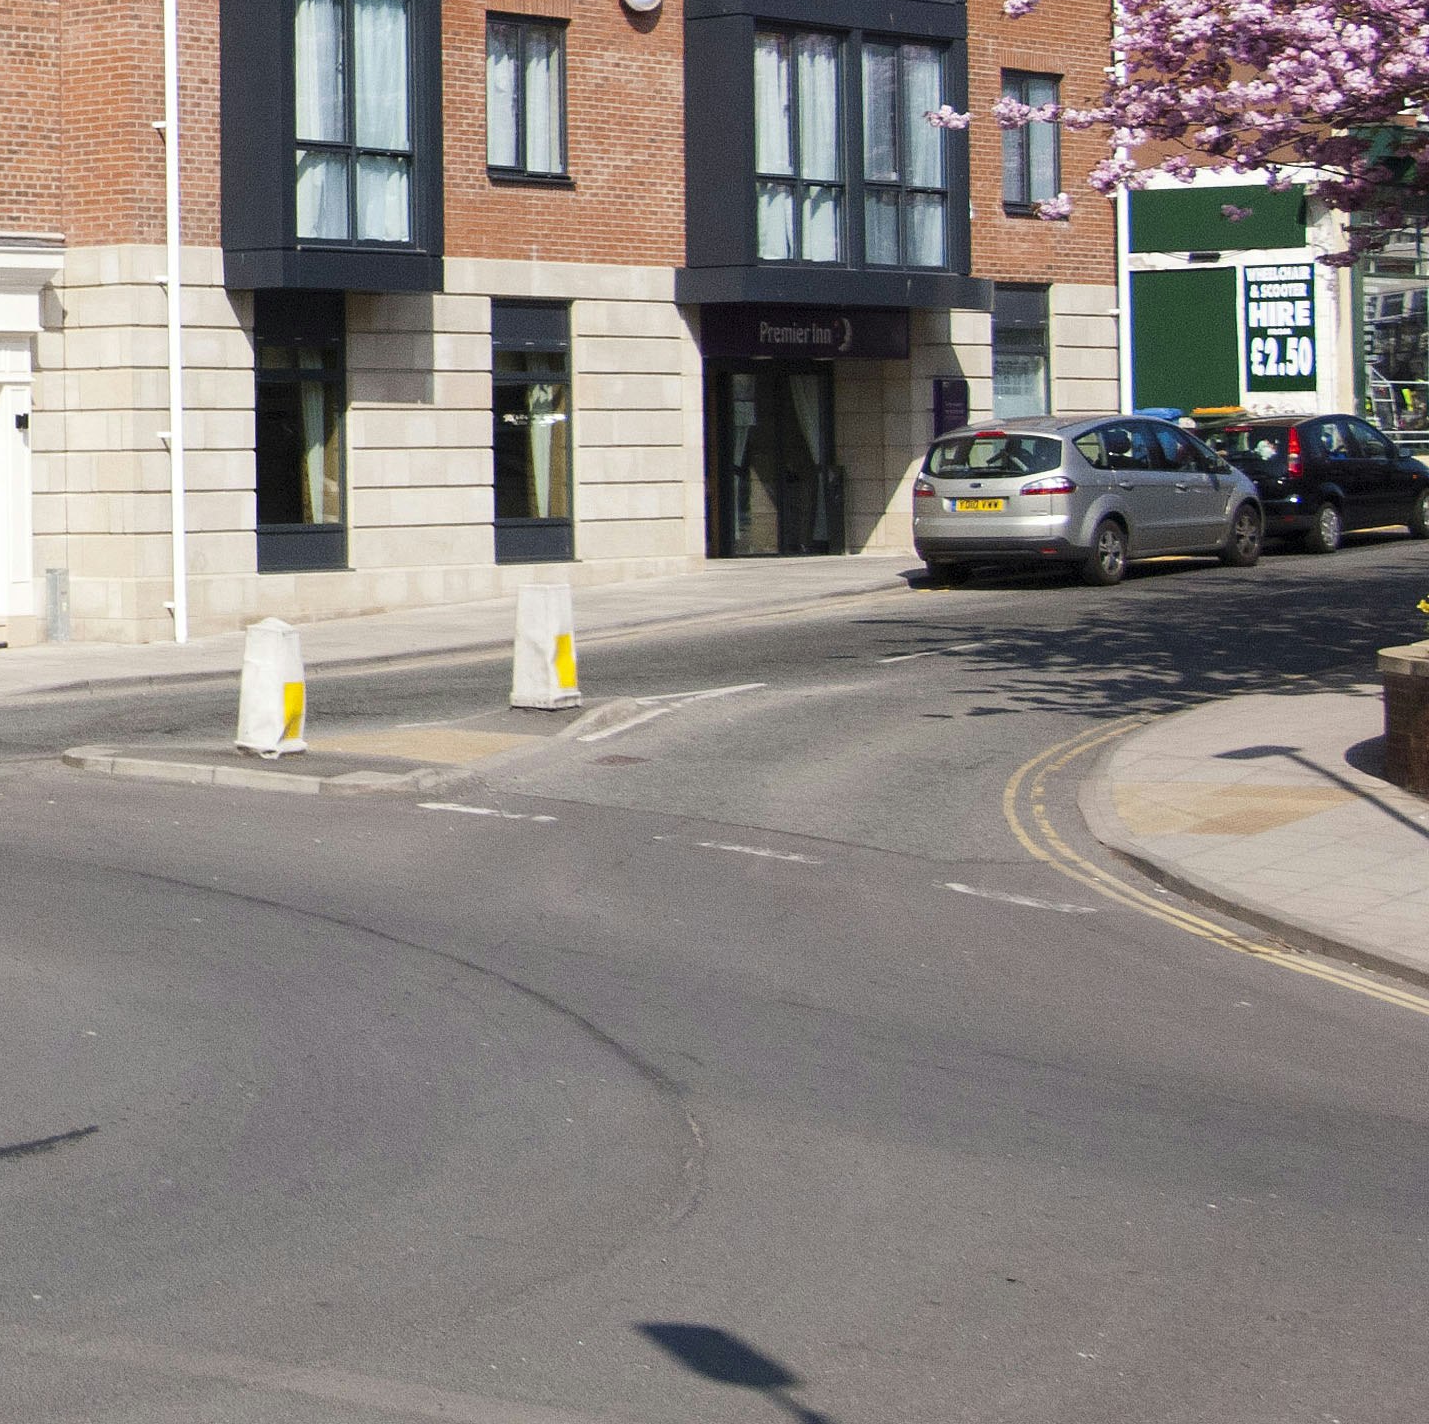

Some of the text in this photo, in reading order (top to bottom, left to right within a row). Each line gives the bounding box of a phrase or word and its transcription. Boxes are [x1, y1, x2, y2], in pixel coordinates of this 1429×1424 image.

[1249, 282, 1308, 299] & SCOOTER
[1248, 300, 1311, 327] HIRE
[760, 321, 832, 344] Premier Inn
[1250, 336, 1313, 376] £2.50
